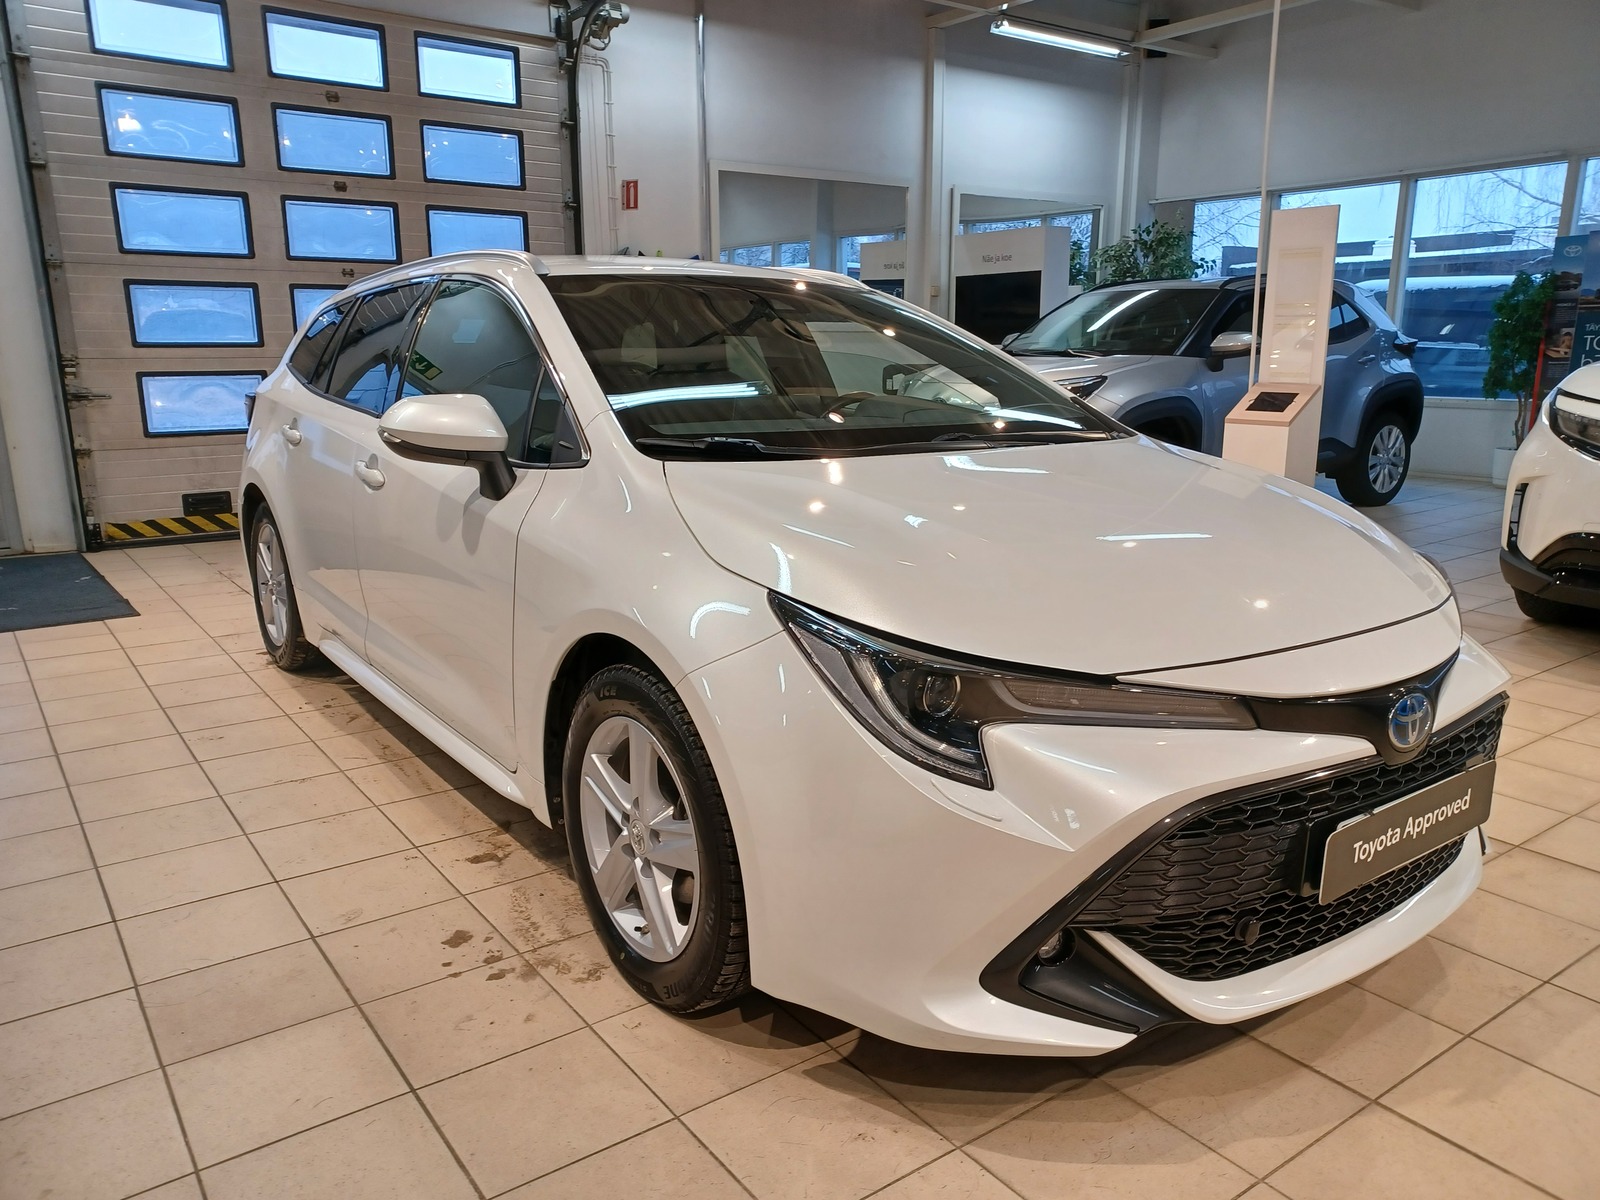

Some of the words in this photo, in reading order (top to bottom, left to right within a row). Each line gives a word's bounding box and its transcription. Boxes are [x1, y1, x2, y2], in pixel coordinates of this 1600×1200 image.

[982, 254, 994, 262] Näe
[1001, 253, 1012, 261] koe
[600, 685, 617, 698] ICE
[1353, 827, 1401, 864] Toyota
[1403, 788, 1471, 839] Approved
